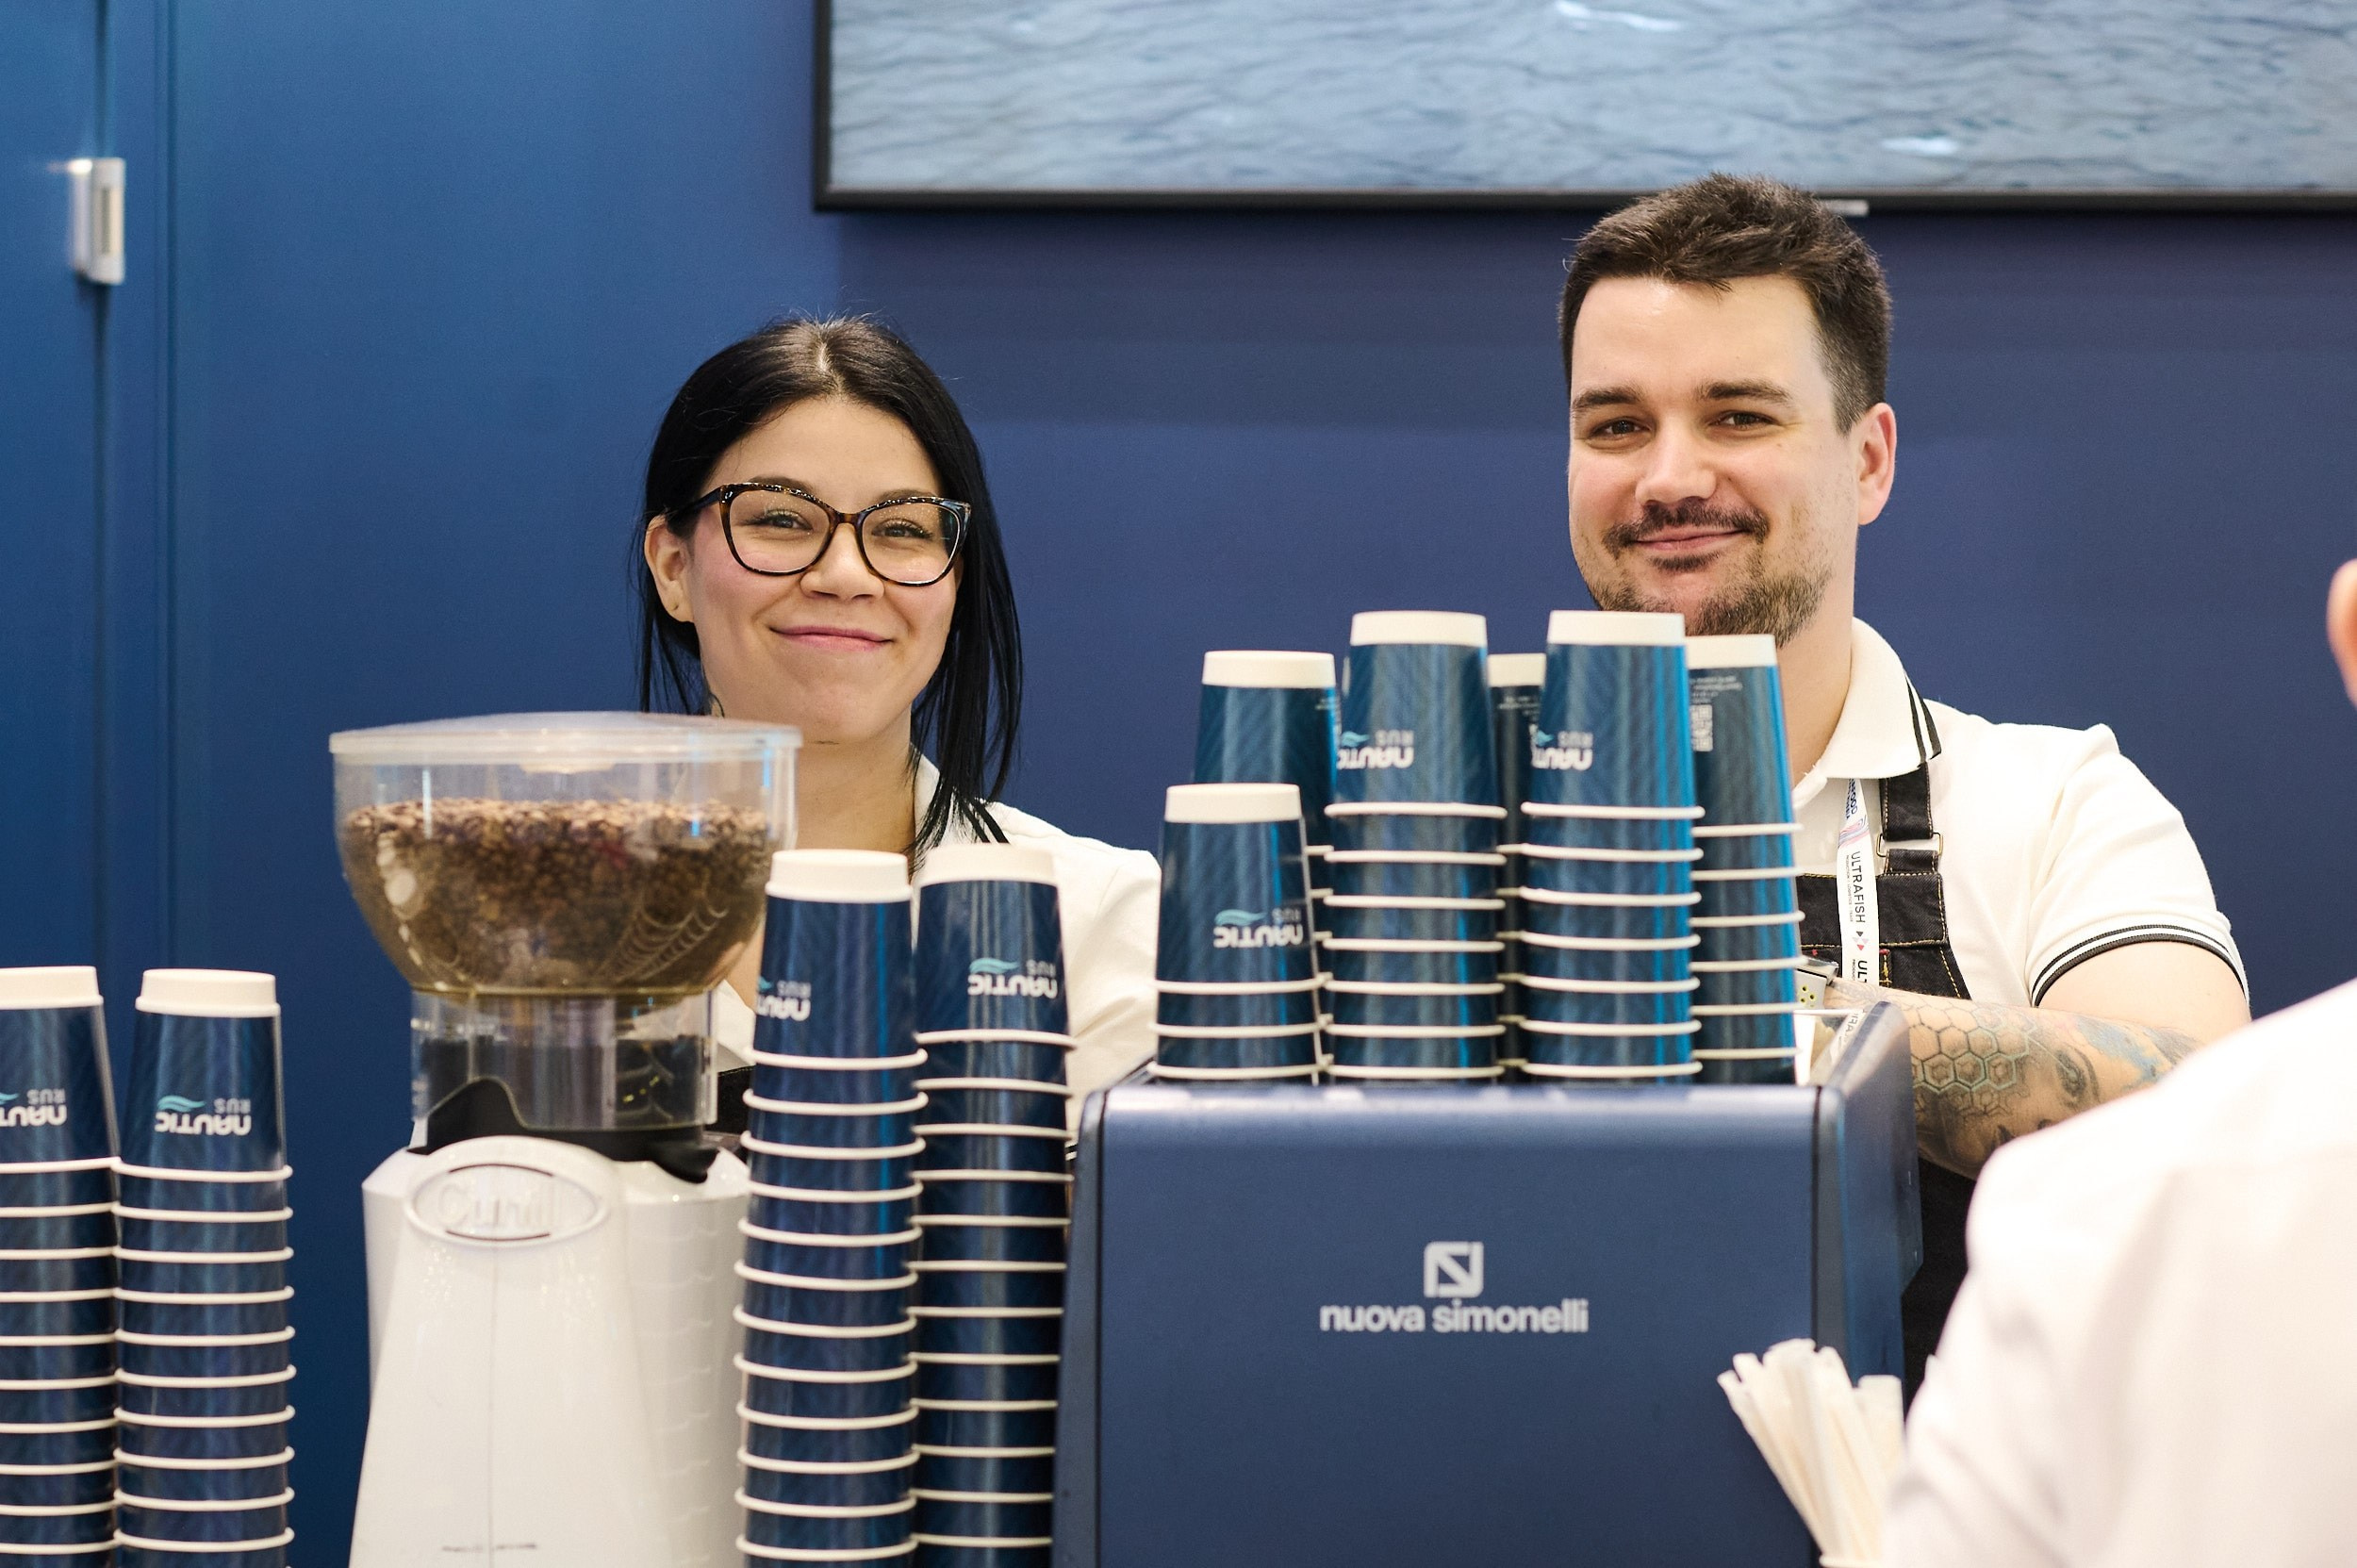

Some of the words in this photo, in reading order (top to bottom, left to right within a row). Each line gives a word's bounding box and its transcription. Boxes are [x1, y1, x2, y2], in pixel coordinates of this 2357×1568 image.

[1336, 747, 1414, 769] NAUTIC
[1851, 851, 1866, 923] ULTRAFISH
[1213, 924, 1303, 948] NAUTIC
[967, 973, 1058, 999] NAUTIC
[26, 1089, 66, 1106] RUS
[213, 1098, 251, 1114] RUS
[0, 1104, 67, 1127] NAUT
[155, 1111, 252, 1135] NAUTIC
[1319, 1304, 1426, 1332] nuova
[1432, 1297, 1589, 1332] simonelli
